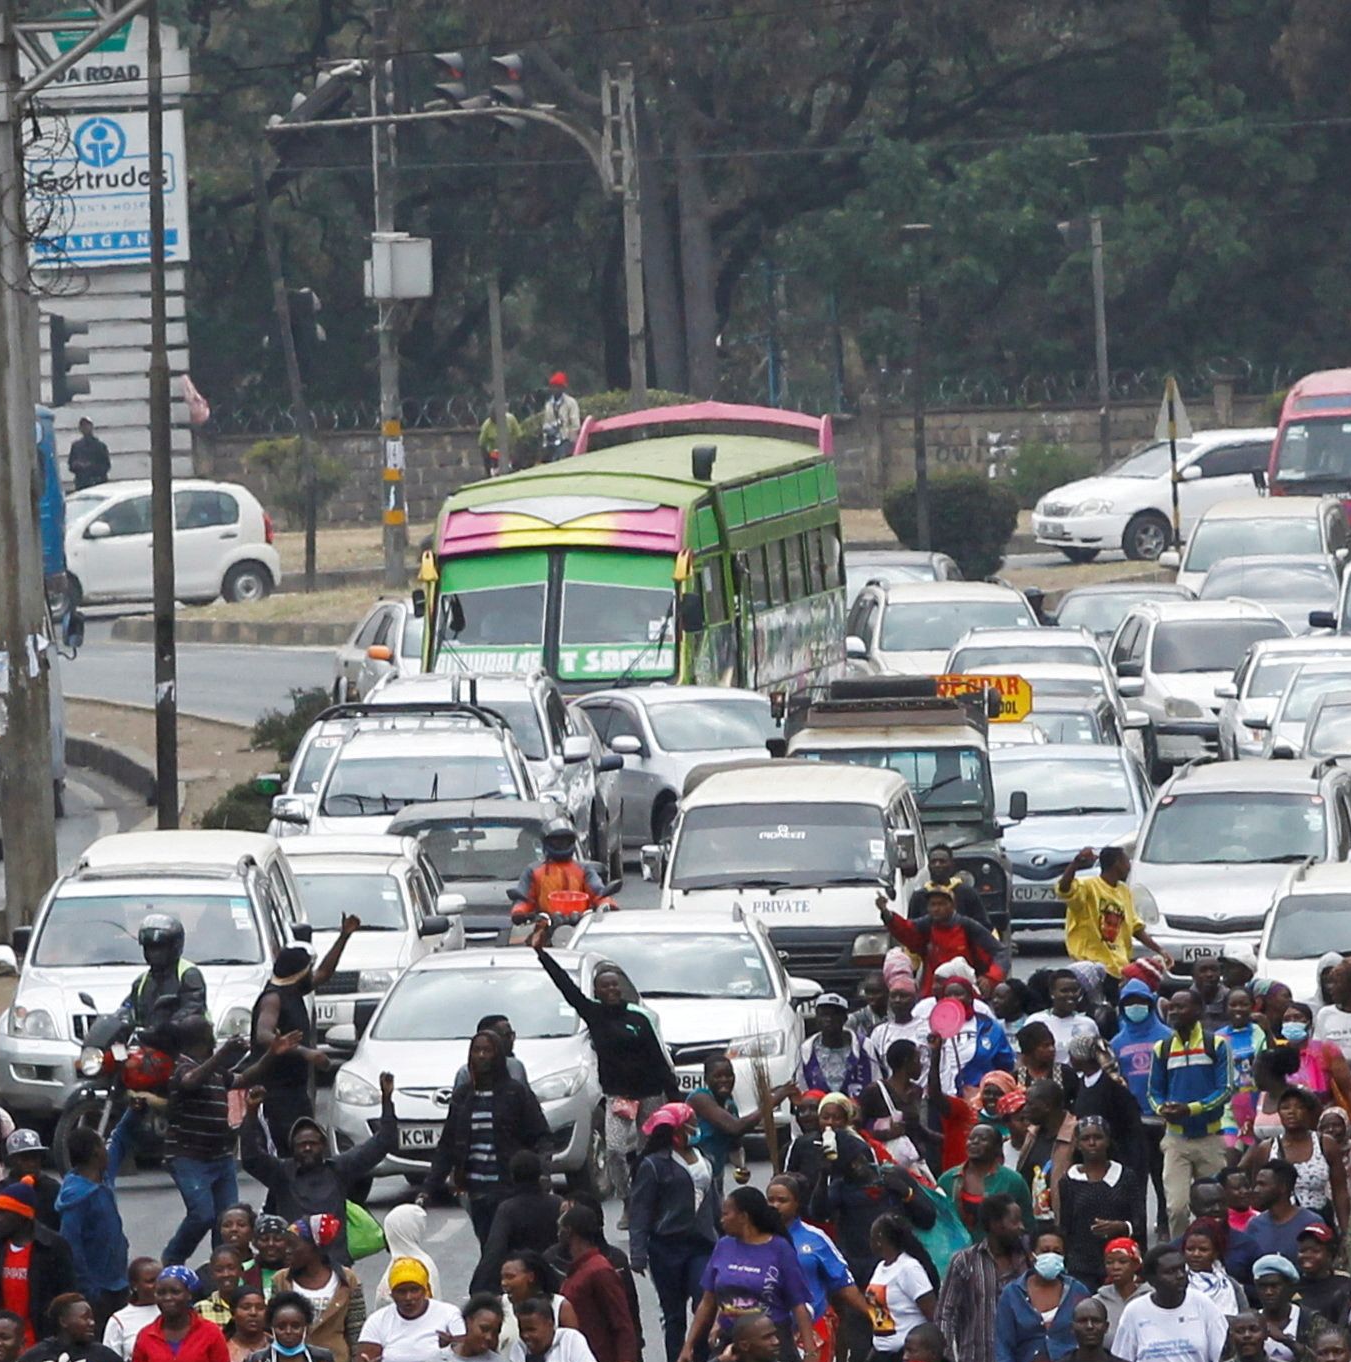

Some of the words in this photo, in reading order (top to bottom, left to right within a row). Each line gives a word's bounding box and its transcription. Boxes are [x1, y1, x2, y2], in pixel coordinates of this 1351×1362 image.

[85, 65, 140, 82] ROAD
[753, 900, 811, 914] PRIVATE
[402, 1127, 434, 1146] KCW
